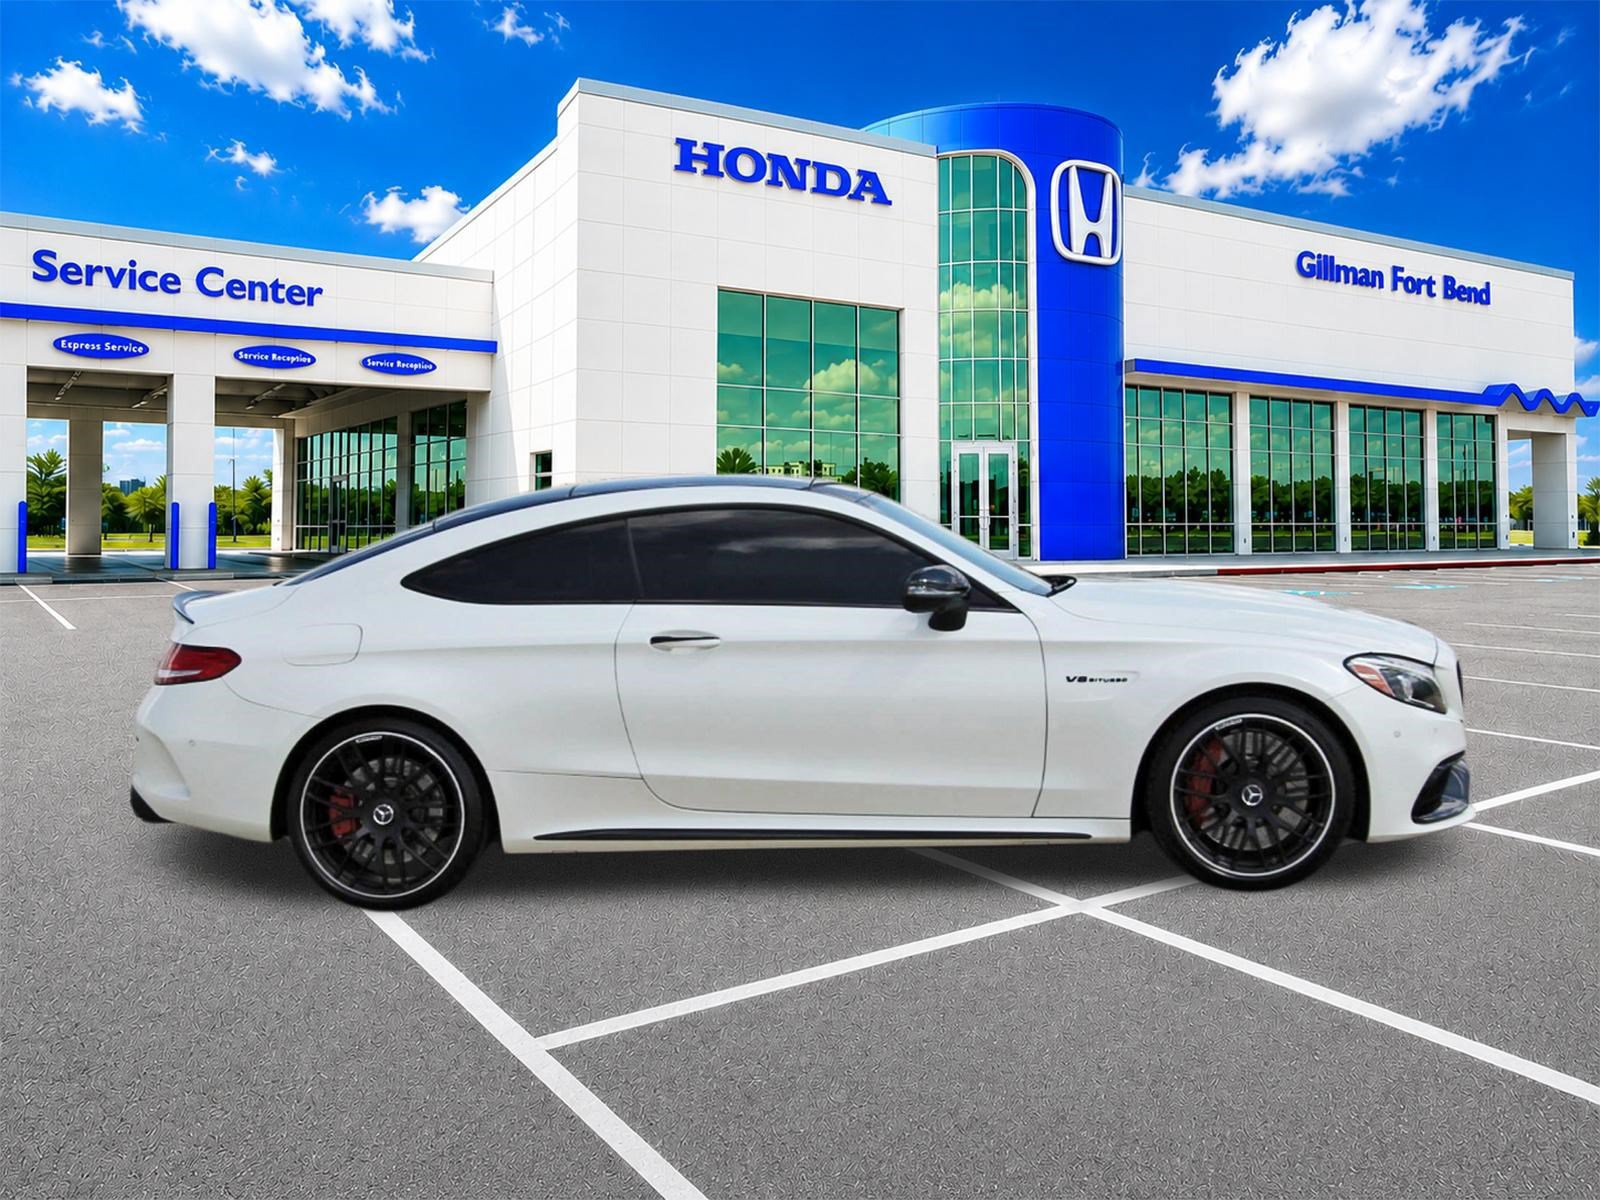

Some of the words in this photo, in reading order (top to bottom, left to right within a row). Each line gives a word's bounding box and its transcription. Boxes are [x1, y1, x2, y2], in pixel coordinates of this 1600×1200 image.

[673, 137, 892, 206] HONDA
[32, 249, 181, 294] Service
[195, 266, 324, 307] Center
[1296, 250, 1384, 290] Gillman
[1391, 265, 1437, 298] Fort
[1443, 275, 1492, 306] Bend
[104, 341, 144, 353] Service
[238, 351, 269, 361] Service
[271, 353, 312, 364] Reception
[366, 358, 394, 368] Service
[1065, 675, 1088, 683] V8
